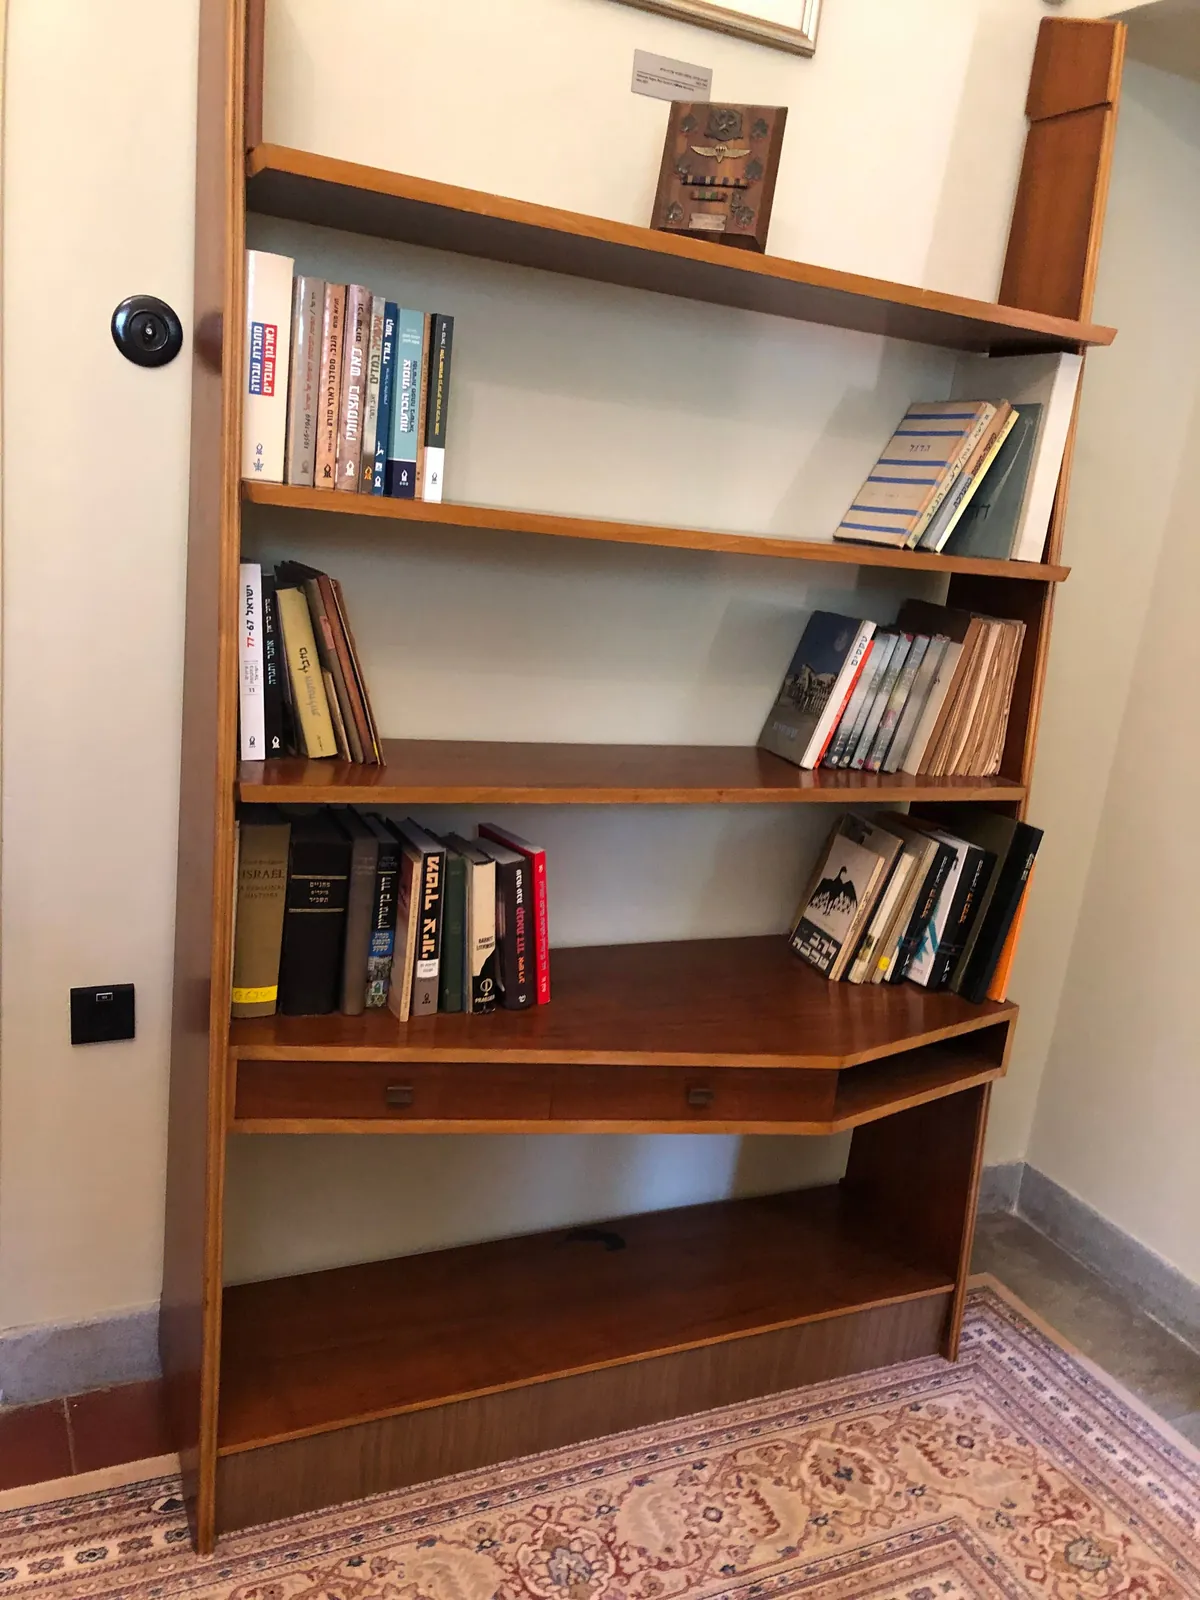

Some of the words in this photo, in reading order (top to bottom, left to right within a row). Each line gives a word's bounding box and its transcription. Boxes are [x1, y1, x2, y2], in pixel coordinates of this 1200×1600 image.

[252, 325, 262, 359] מחברת
[263, 327, 275, 358] לארגון
[354, 319, 362, 342] שלום
[385, 318, 394, 337] קשר
[349, 345, 362, 376] כאש
[383, 342, 391, 364] גורדי
[251, 362, 260, 391] עבודה
[263, 361, 272, 393] עובדים
[369, 354, 379, 384] במדים
[401, 359, 410, 389] צומתי
[326, 386, 334, 406] לארץ
[345, 384, 361, 440] בעצמותיו
[400, 392, 409, 432] הכרעות
[244, 584, 253, 615] ישראל
[266, 639, 274, 659] אתגר
[267, 662, 276, 684] ותגרה
[242, 869, 284, 879] ISRAEL
[380, 877, 390, 891] דוד
[424, 855, 440, 910] מטיף
[422, 918, 437, 959] ציוני
[516, 937, 524, 953] דוד
